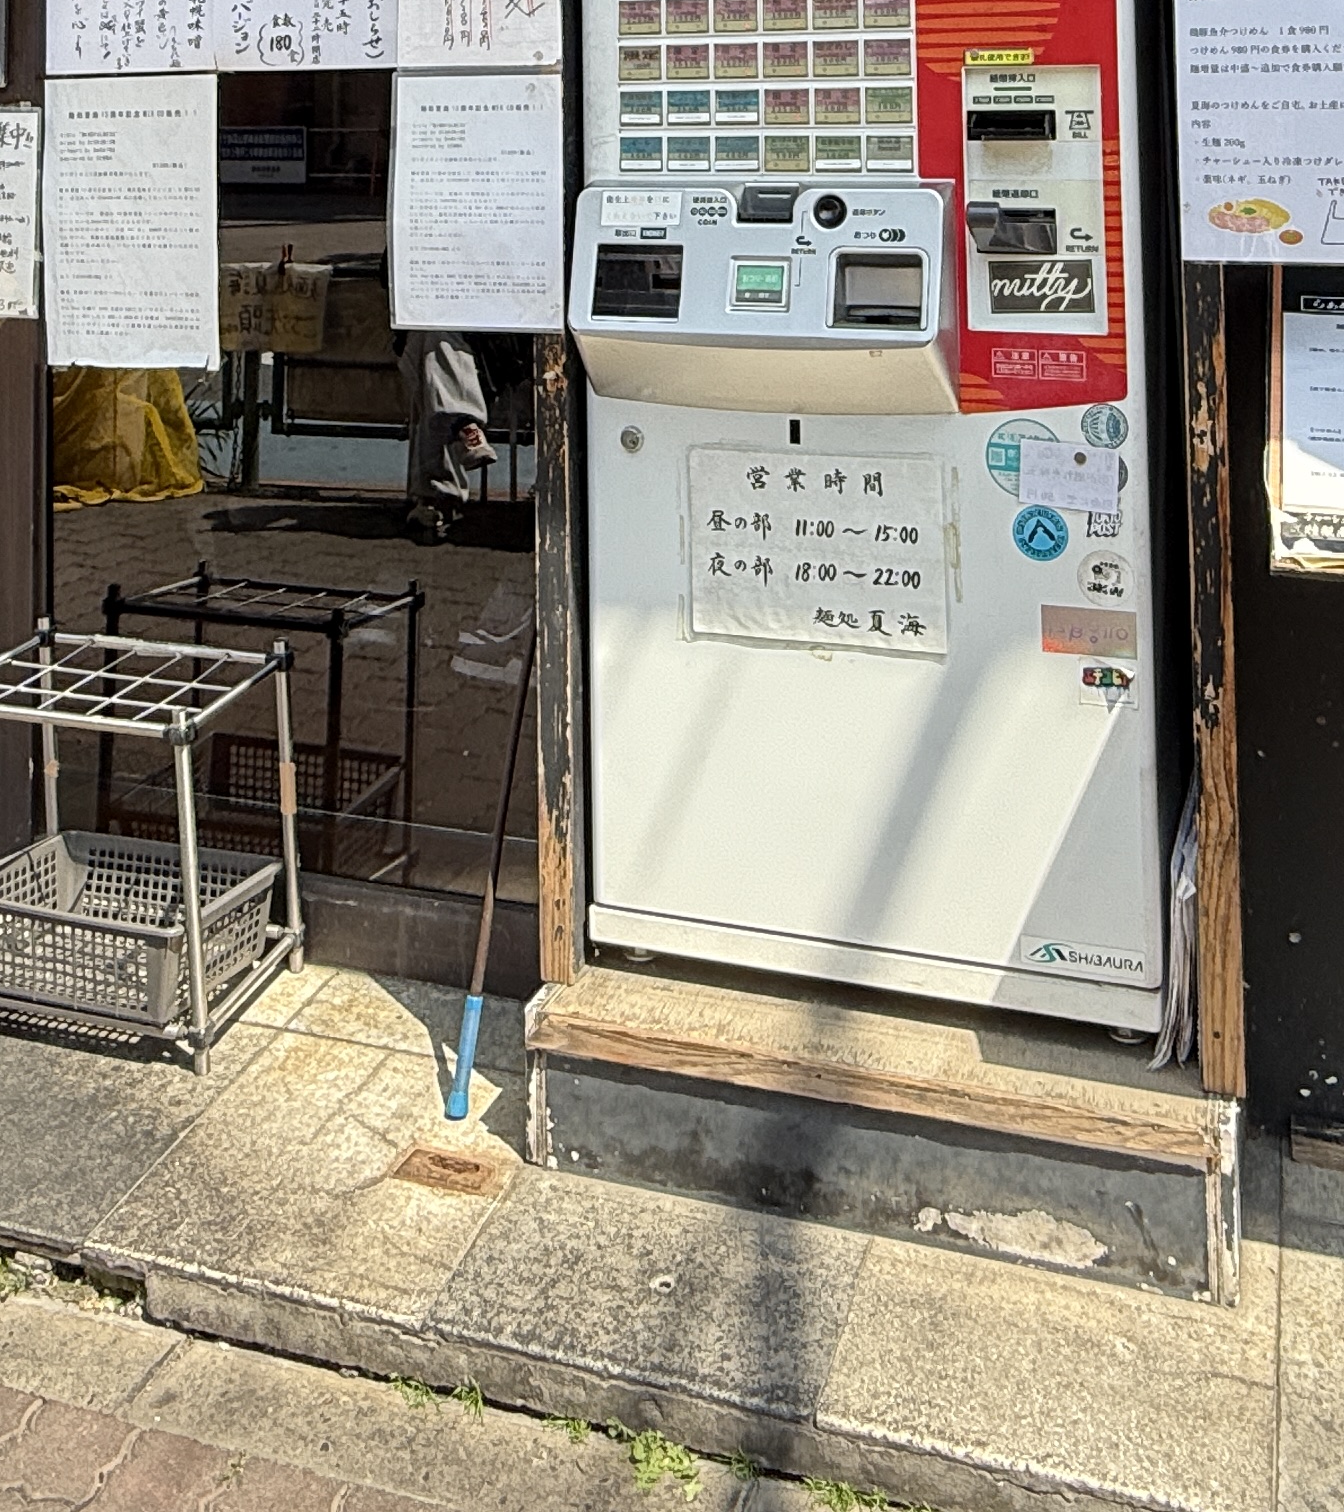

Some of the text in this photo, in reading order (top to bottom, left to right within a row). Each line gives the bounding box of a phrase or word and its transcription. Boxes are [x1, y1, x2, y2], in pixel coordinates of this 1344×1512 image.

[1065, 244, 1099, 253] RETURN
[746, 465, 884, 497] 営業時間
[707, 510, 772, 541] 昼の部
[795, 519, 834, 539] 11:00
[874, 524, 919, 544] 15:00
[707, 552, 773, 587] 夜の部
[795, 562, 837, 583] 18:00
[872, 568, 921, 589] 22:00
[1068, 951, 1144, 973] SHIBAURA
